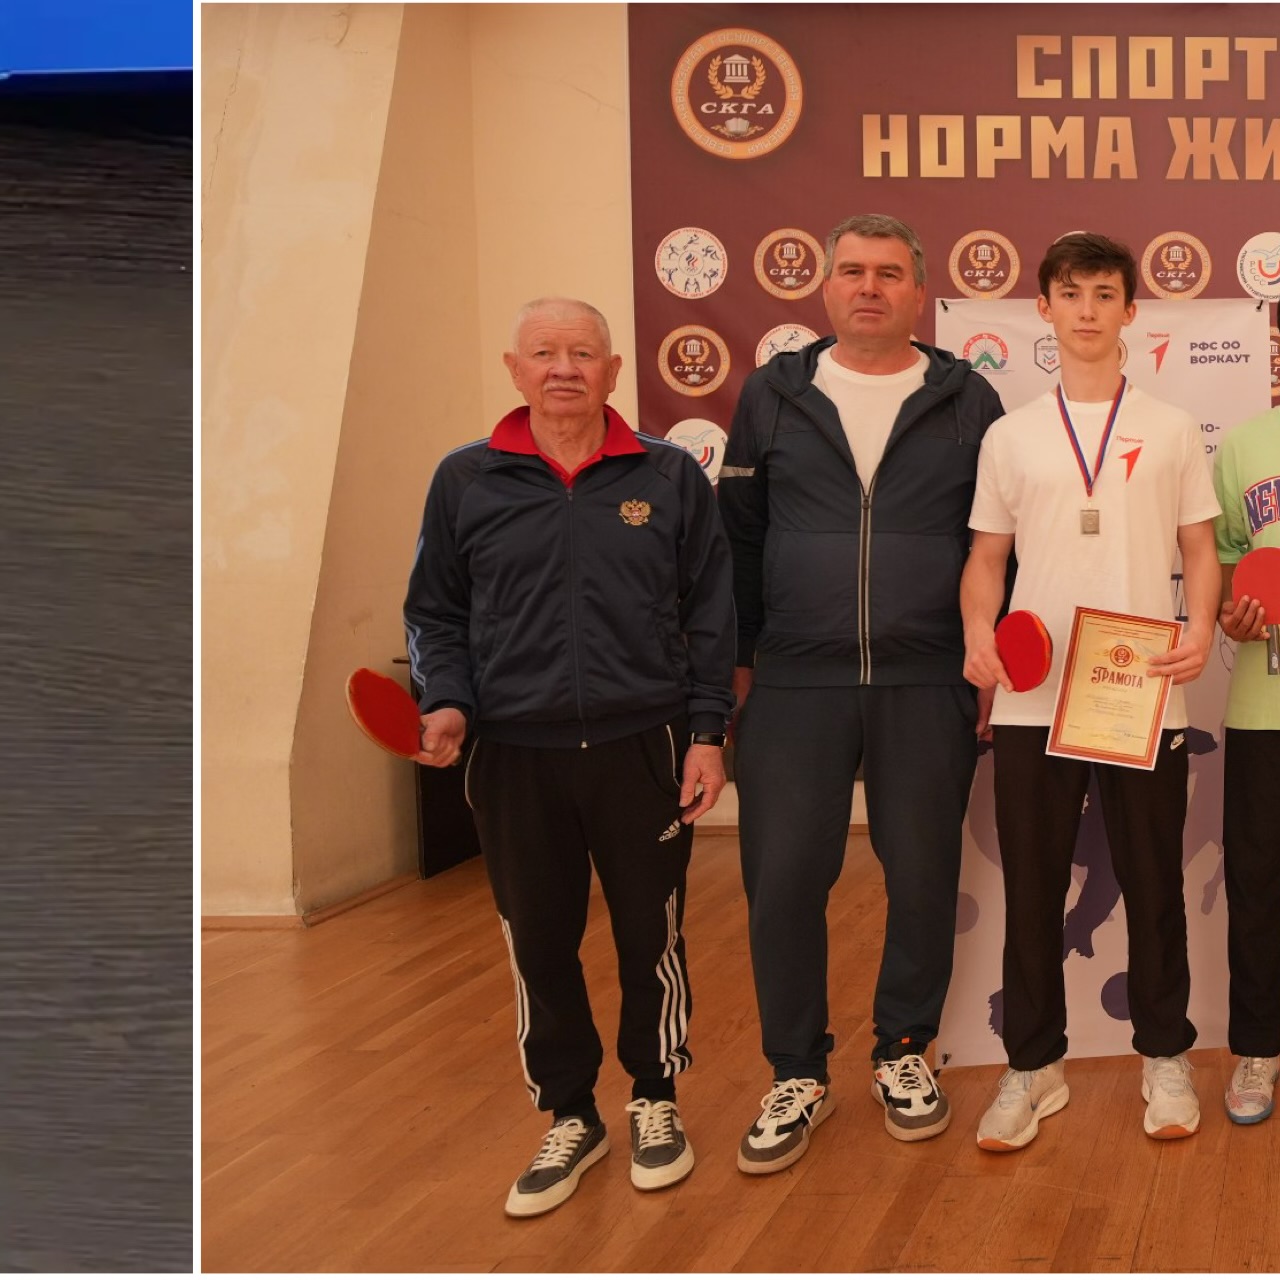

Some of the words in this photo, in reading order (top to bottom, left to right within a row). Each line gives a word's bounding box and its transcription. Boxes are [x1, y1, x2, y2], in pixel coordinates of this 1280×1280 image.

[1016, 35, 1277, 100] СПОРТ
[701, 102, 774, 114] СКГА
[863, 114, 1137, 179] НОРМА
[769, 268, 811, 276] СКГА
[964, 269, 1005, 278] СКГА
[1156, 270, 1196, 279] СКГА
[1190, 342, 1218, 351] РФС
[1190, 354, 1251, 364] ВОРКАУТ
[674, 365, 715, 373] СКГА
[1091, 666, 1144, 689] ГРАМОТА
